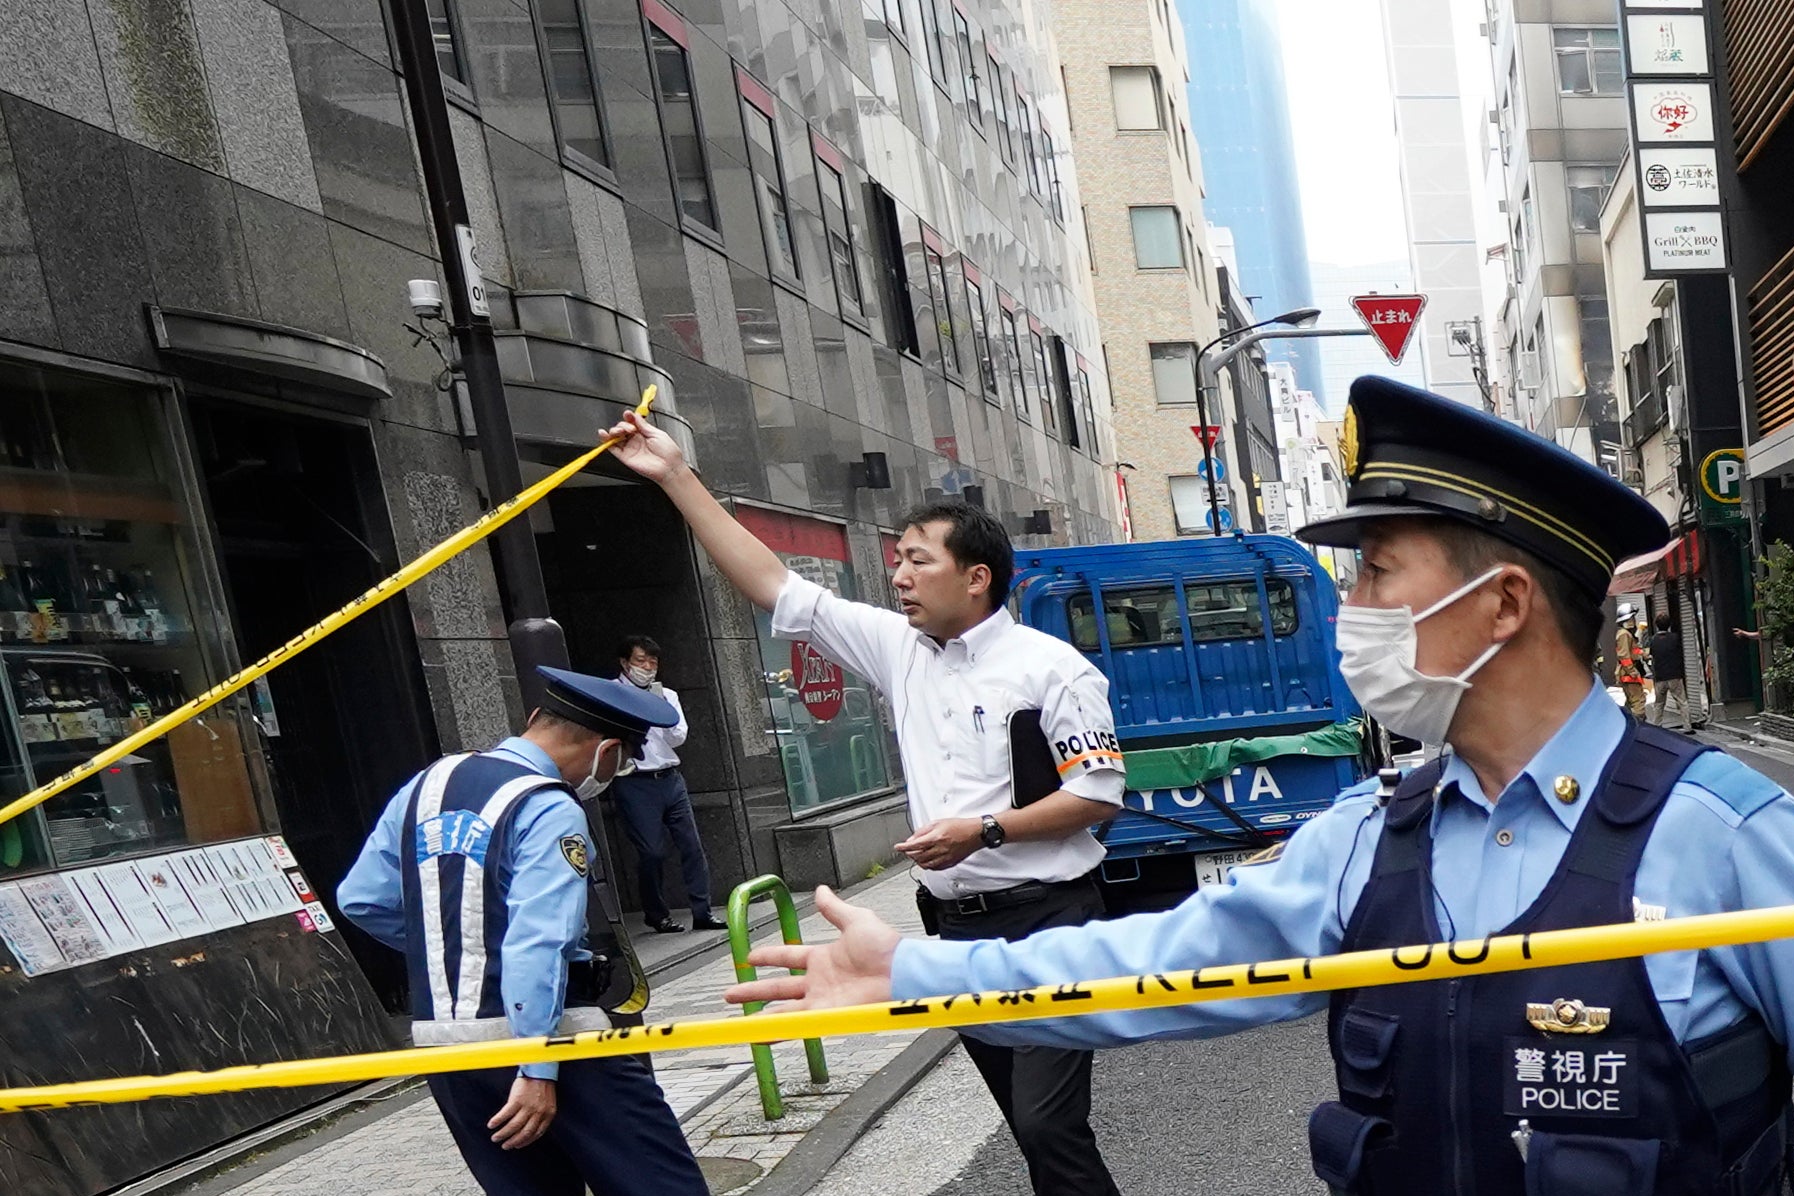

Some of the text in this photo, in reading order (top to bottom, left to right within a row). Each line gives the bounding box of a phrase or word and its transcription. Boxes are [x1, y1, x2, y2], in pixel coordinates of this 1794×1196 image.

[1658, 105, 1689, 120] 你好
[1674, 168, 1714, 179] 土佐清水
[1679, 180, 1712, 189] ワールド
[1654, 235, 1718, 247] Grill BBQ
[1371, 309, 1412, 325] 止まれ
[1716, 461, 1740, 494] P
[1056, 730, 1118, 762] POLICE
[1296, 811, 1325, 820] DYN
[1514, 1048, 1627, 1084] 警視庁
[1522, 1087, 1620, 1111] POLICE
